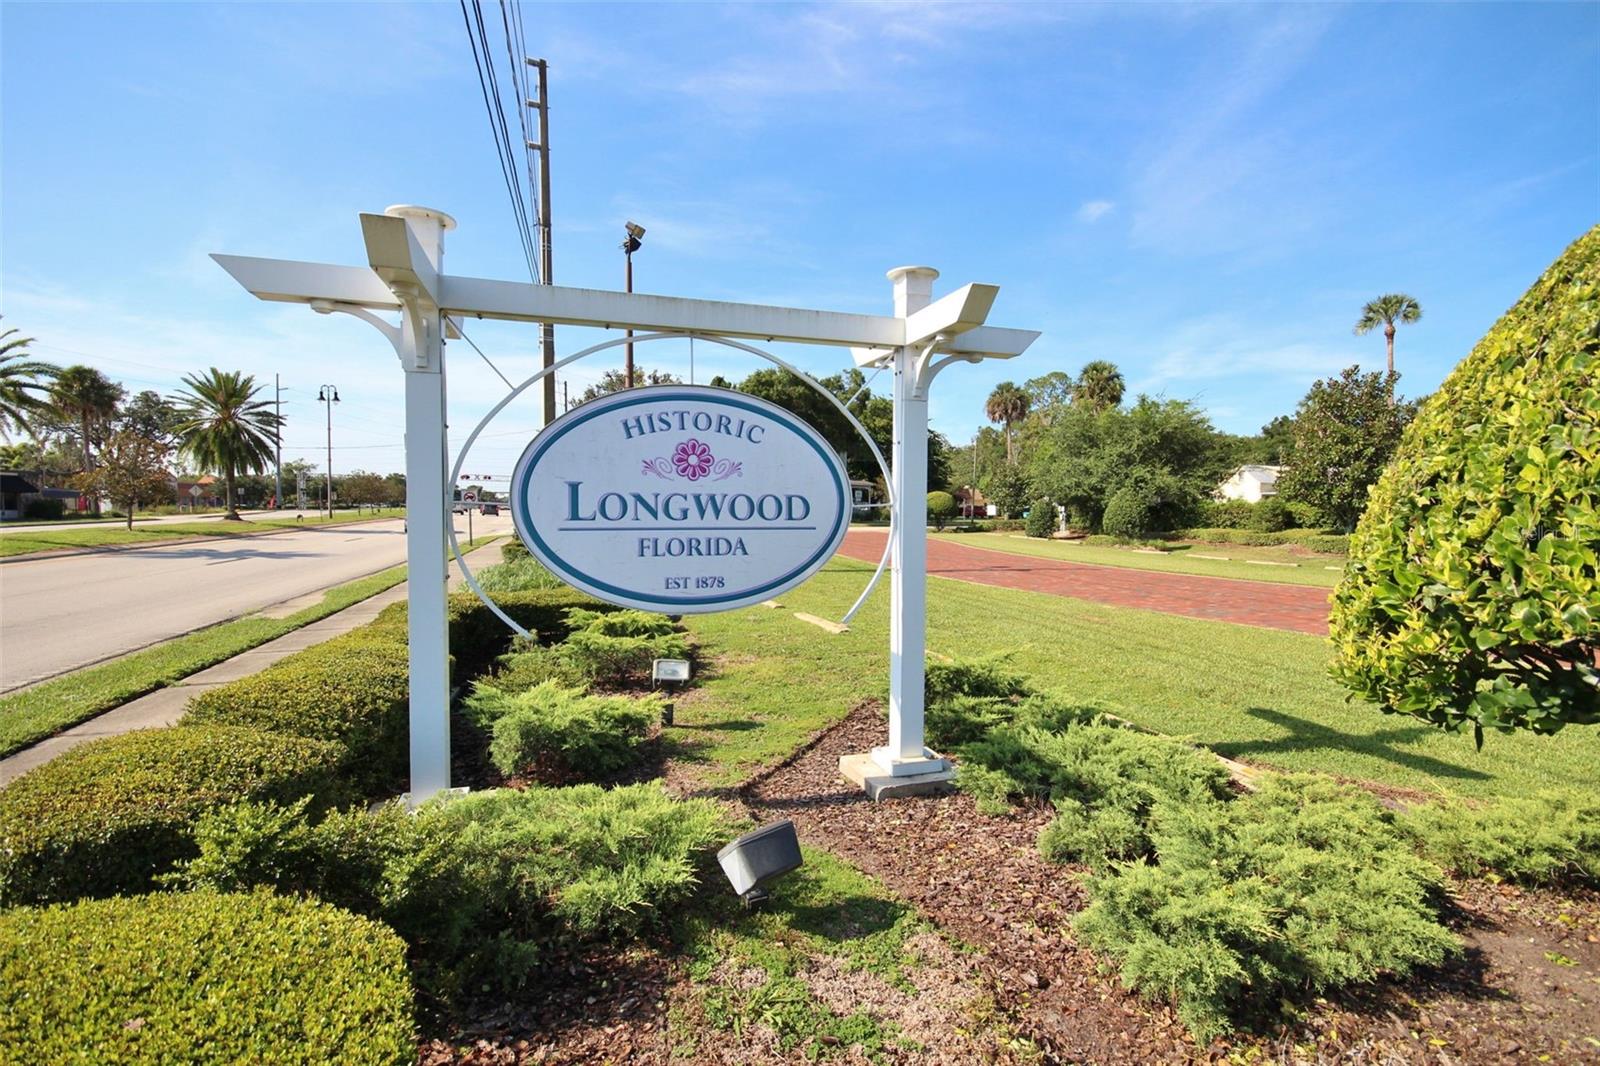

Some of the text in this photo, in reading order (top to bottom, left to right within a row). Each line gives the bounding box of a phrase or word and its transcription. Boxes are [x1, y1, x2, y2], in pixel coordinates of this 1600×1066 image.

[621, 411, 765, 444] HISTORIC
[564, 481, 811, 522] LONGWOOD
[638, 537, 749, 557] FLORIDA
[664, 576, 725, 590] EST 1878
